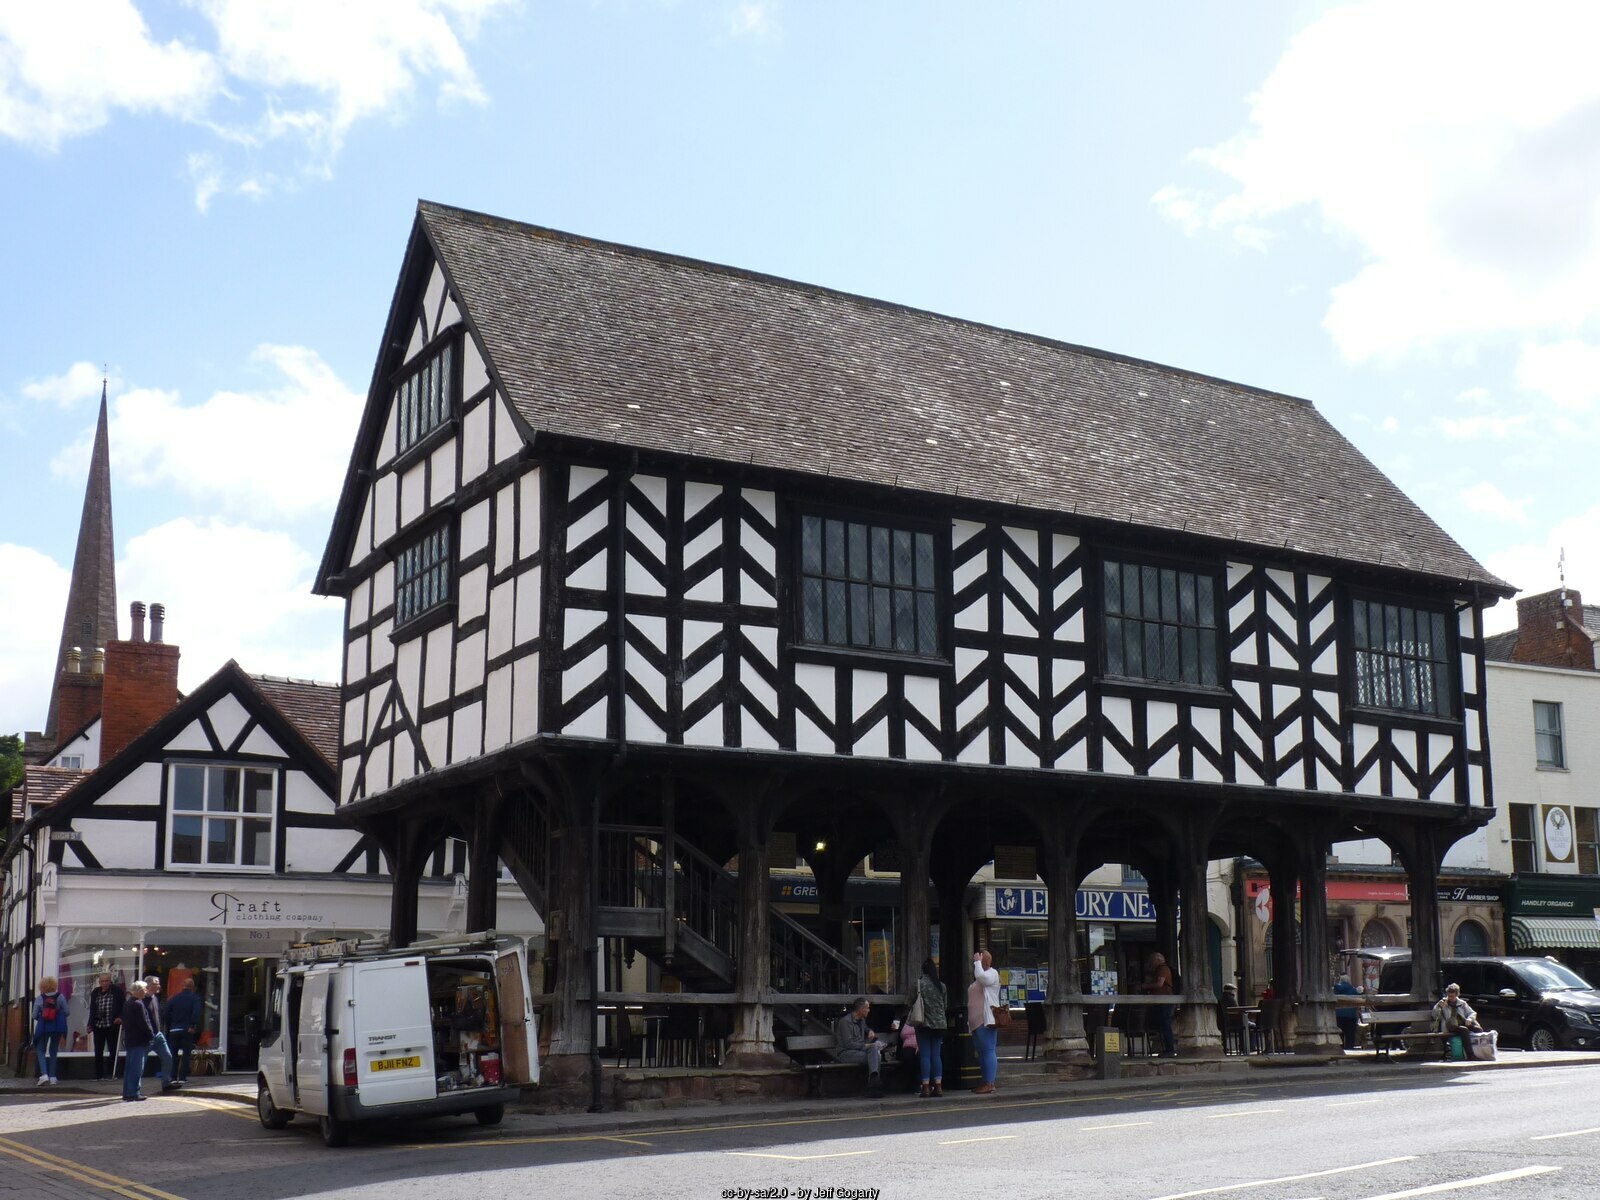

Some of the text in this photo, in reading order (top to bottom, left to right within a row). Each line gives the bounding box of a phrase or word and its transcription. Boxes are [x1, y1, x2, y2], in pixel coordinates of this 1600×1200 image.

[793, 886, 818, 896] GRE
[1020, 889, 1157, 918] LEURY NE
[286, 914, 323, 922] company
[249, 931, 271, 939] No.1
[396, 1058, 414, 1068] FNZ
